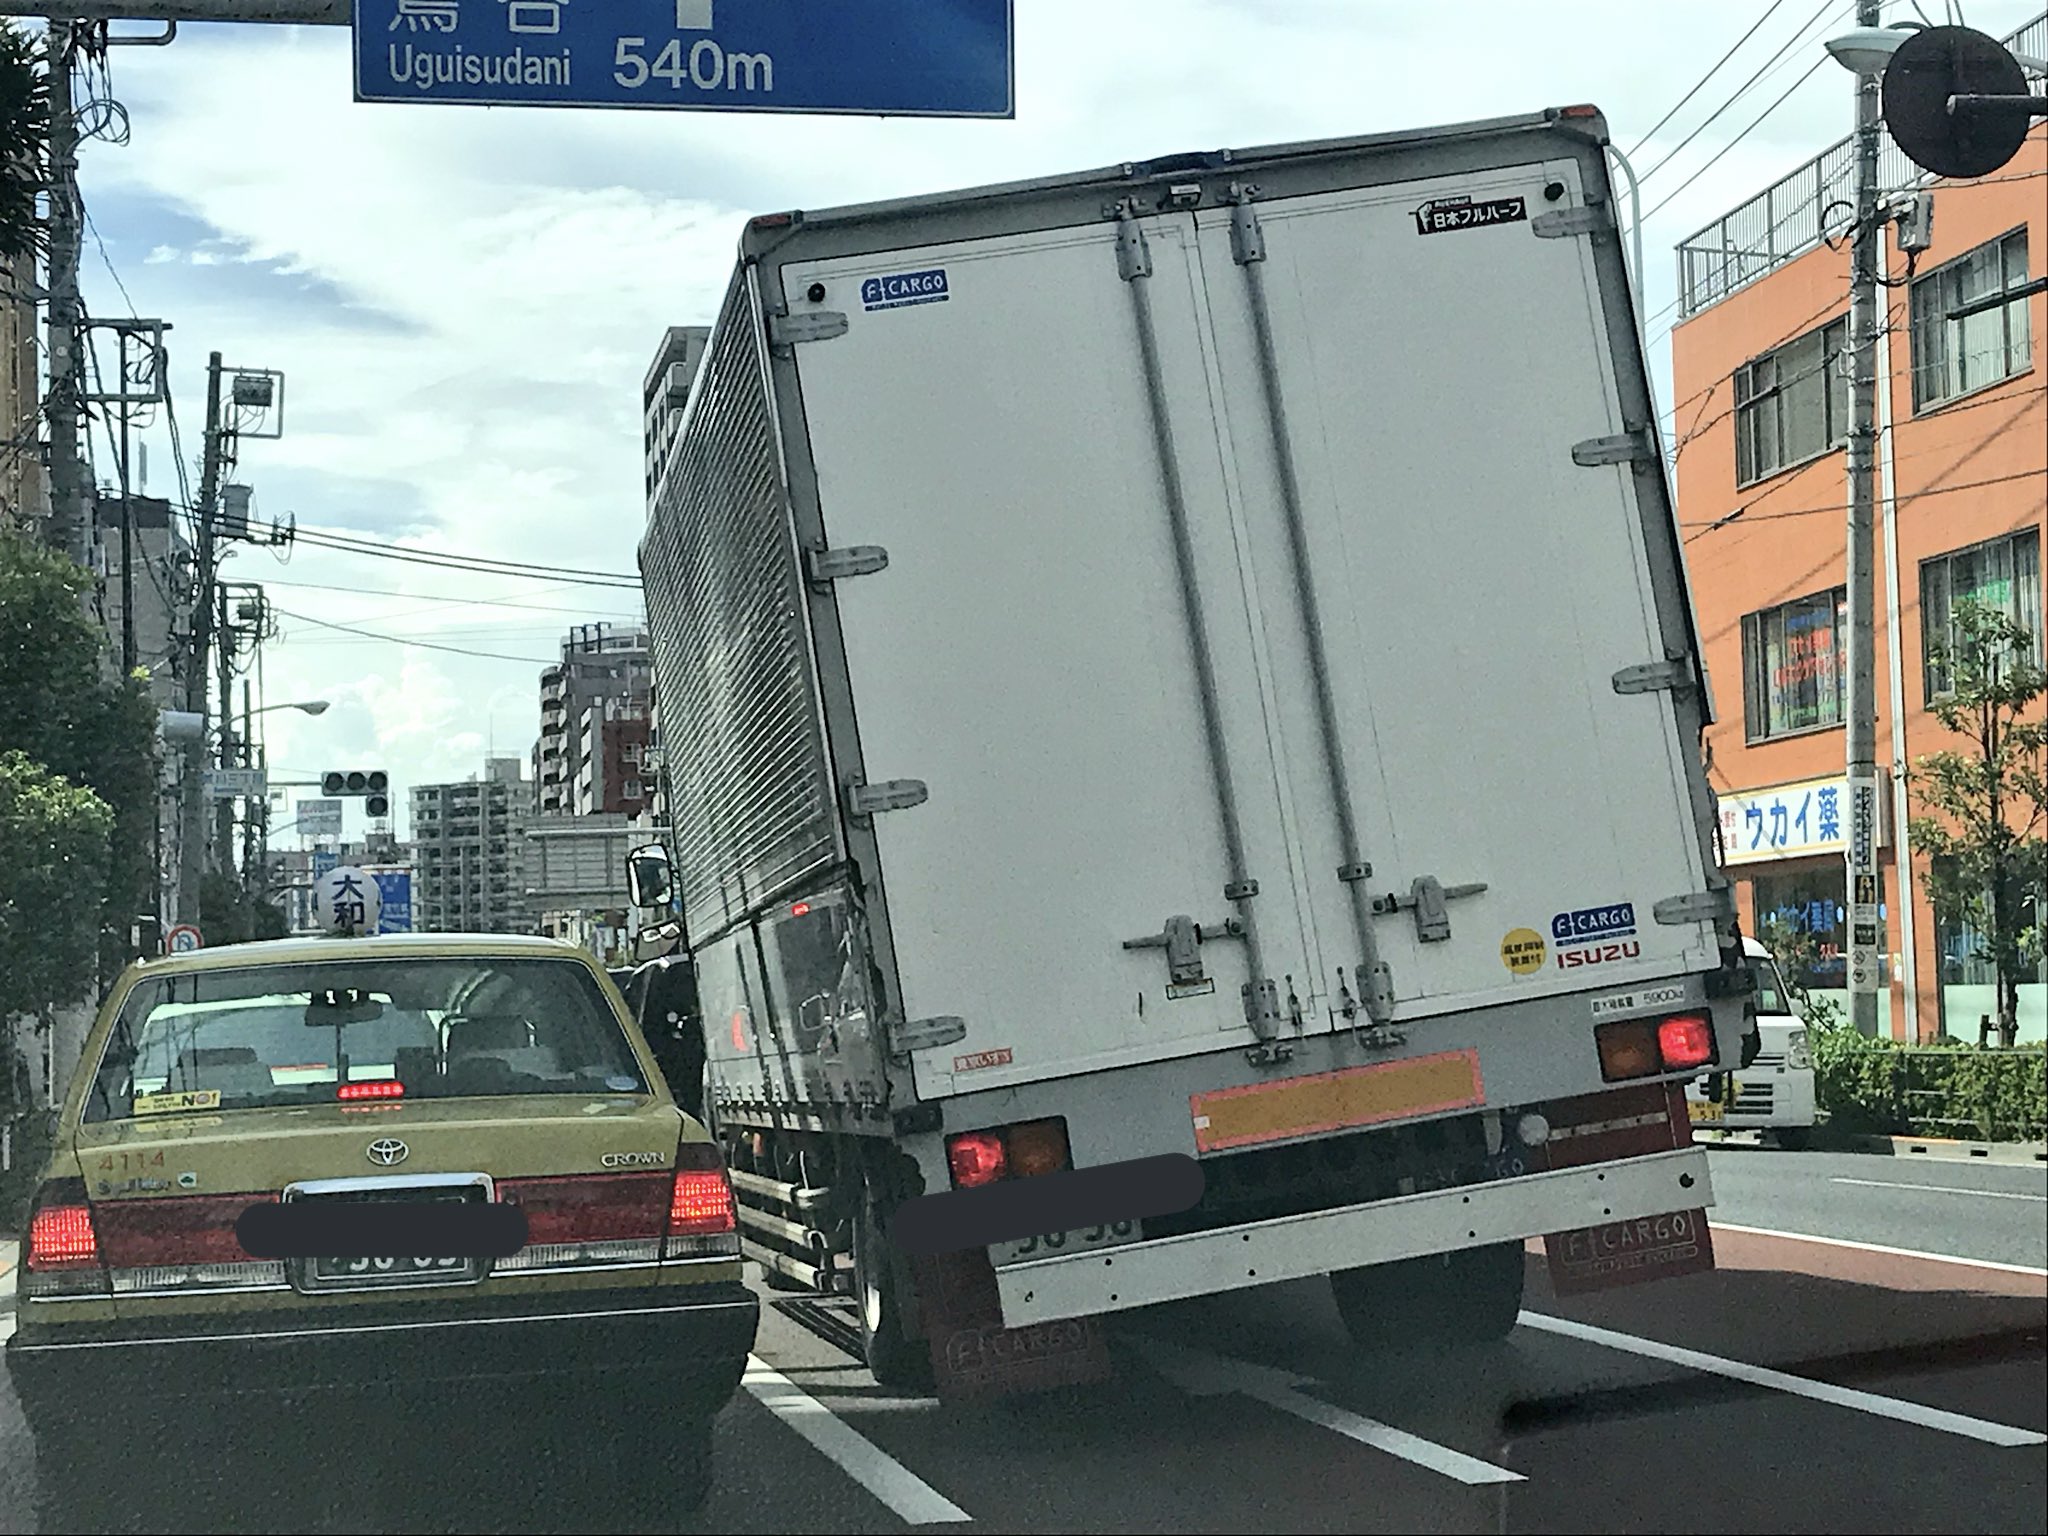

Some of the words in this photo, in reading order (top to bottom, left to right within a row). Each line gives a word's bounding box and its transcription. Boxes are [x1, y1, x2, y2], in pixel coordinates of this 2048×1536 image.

[388, 44, 572, 90] Uguisudani
[613, 37, 773, 92] 540m
[1433, 201, 1522, 229] 日本フルハーフ
[331, 874, 365, 928] 大和
[1556, 940, 1641, 970] ISUZU
[98, 1151, 166, 1172] 4114
[600, 1151, 666, 1168] CROWN
